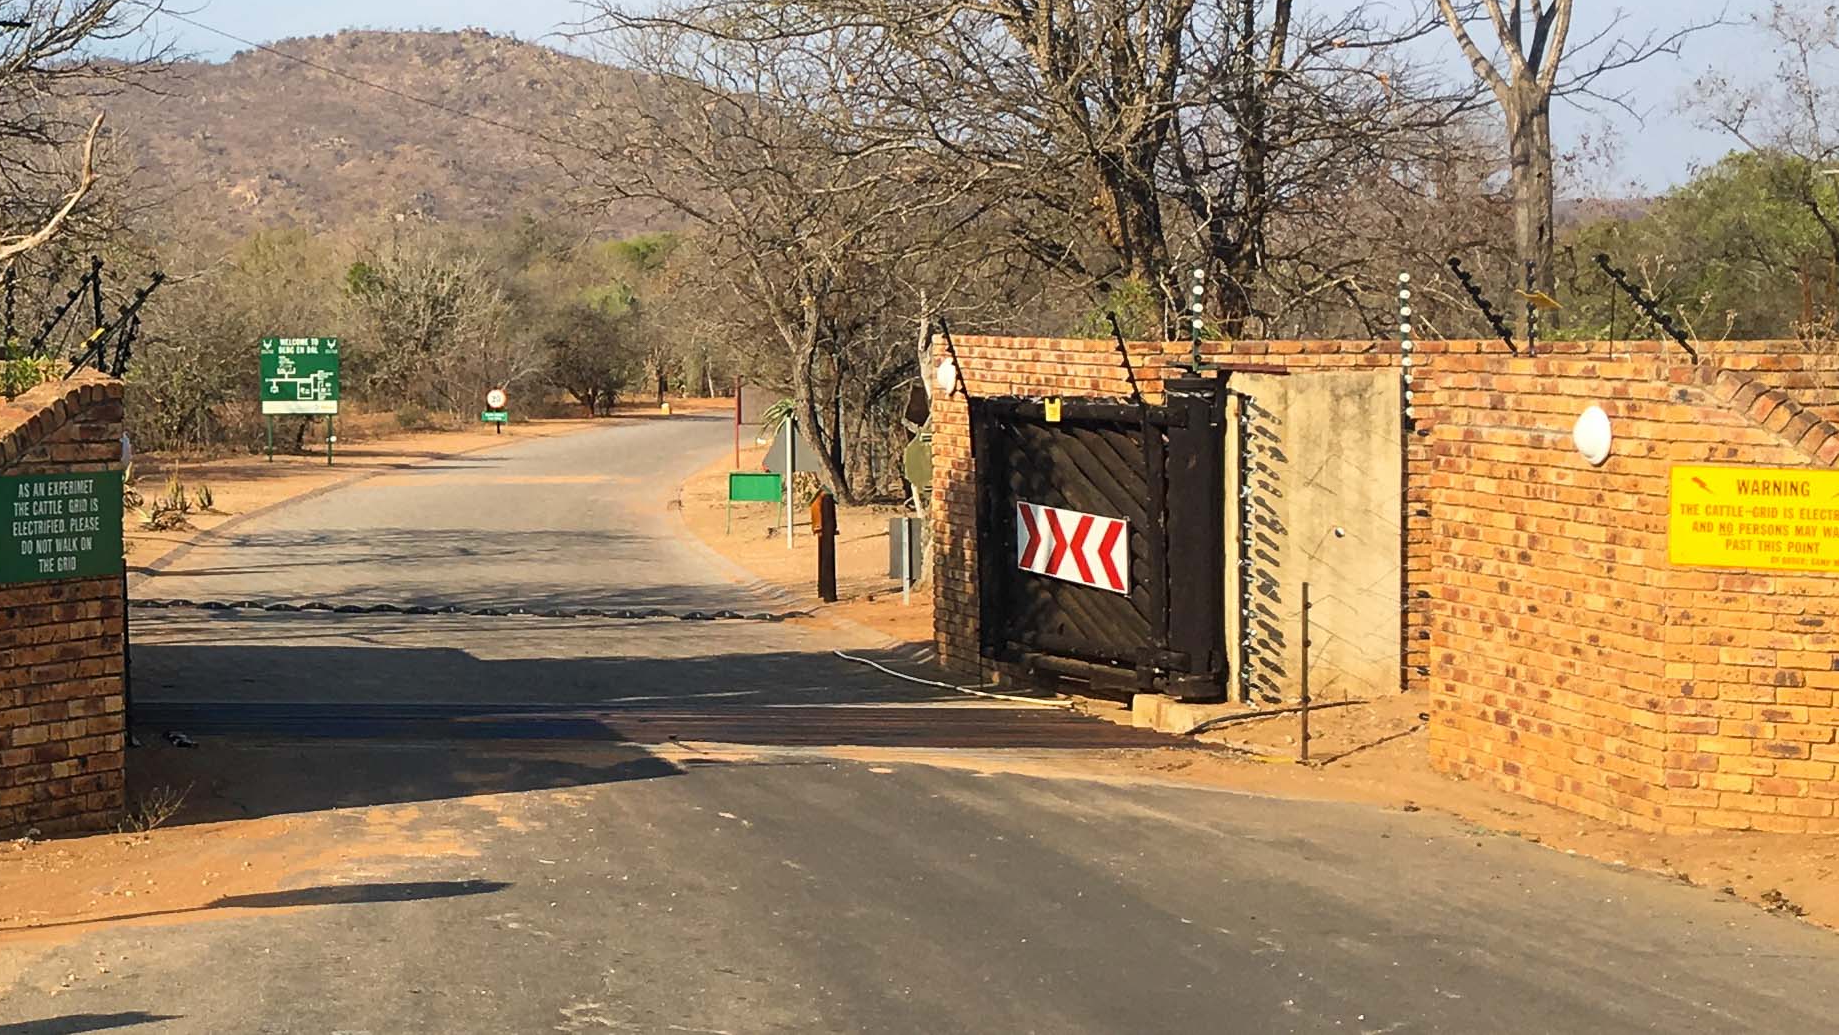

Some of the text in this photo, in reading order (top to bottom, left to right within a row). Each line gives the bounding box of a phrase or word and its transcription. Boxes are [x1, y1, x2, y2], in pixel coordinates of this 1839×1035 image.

[18, 479, 94, 498] AS AN EXPERIMET
[1737, 479, 1810, 497] WARNING
[13, 498, 99, 517] THE CATTLE GRID IS
[1680, 503, 1699, 516] THE
[1783, 508, 1794, 519] IS
[70, 517, 100, 532] PLEASE
[1692, 521, 1713, 533] AND
[1719, 523, 1734, 535] NO
[1738, 524, 1789, 536] PERSONS
[1795, 525, 1818, 537] MAY
[21, 537, 92, 555] DO NOT WALK ON
[1725, 539, 1820, 554] PAST THIS POINT
[39, 557, 77, 573] THE GRID
